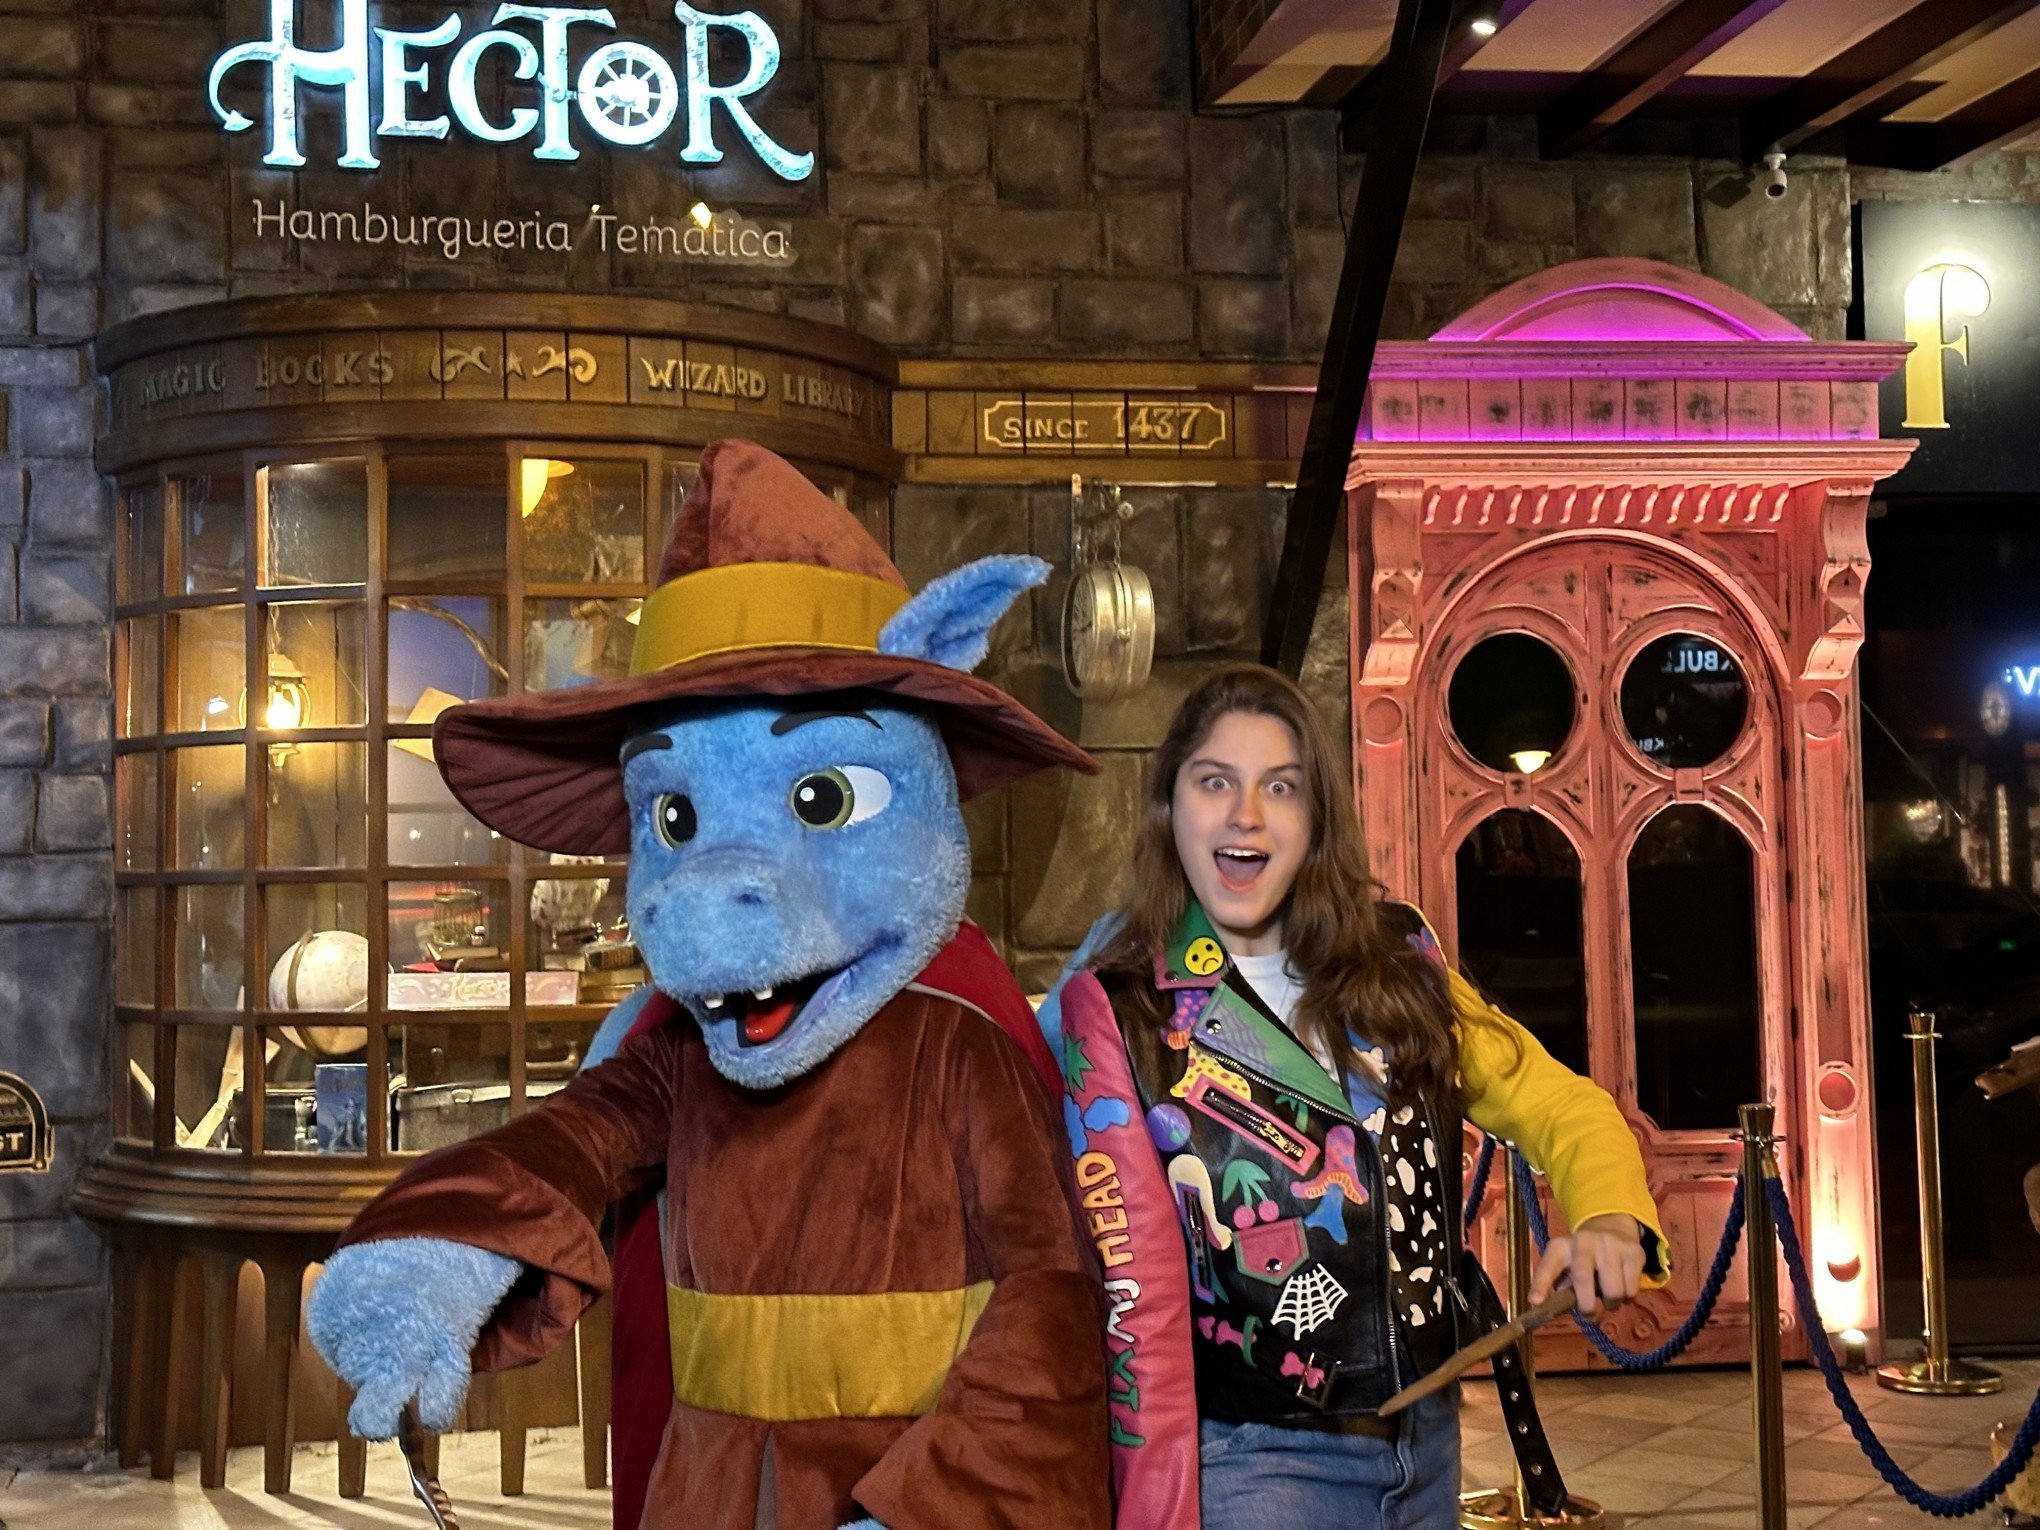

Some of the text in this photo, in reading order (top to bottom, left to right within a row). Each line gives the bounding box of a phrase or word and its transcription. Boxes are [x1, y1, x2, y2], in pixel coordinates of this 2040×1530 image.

[209, 0, 816, 181] HECTOR
[252, 198, 573, 260] Hamburgueria
[142, 351, 394, 402] MAGIC BOOKS
[641, 356, 768, 398] WIZARD
[1003, 407, 1202, 440] SINCE 1437
[1075, 1150, 1135, 1268] HEAD
[1108, 1346, 1146, 1448] FIX
